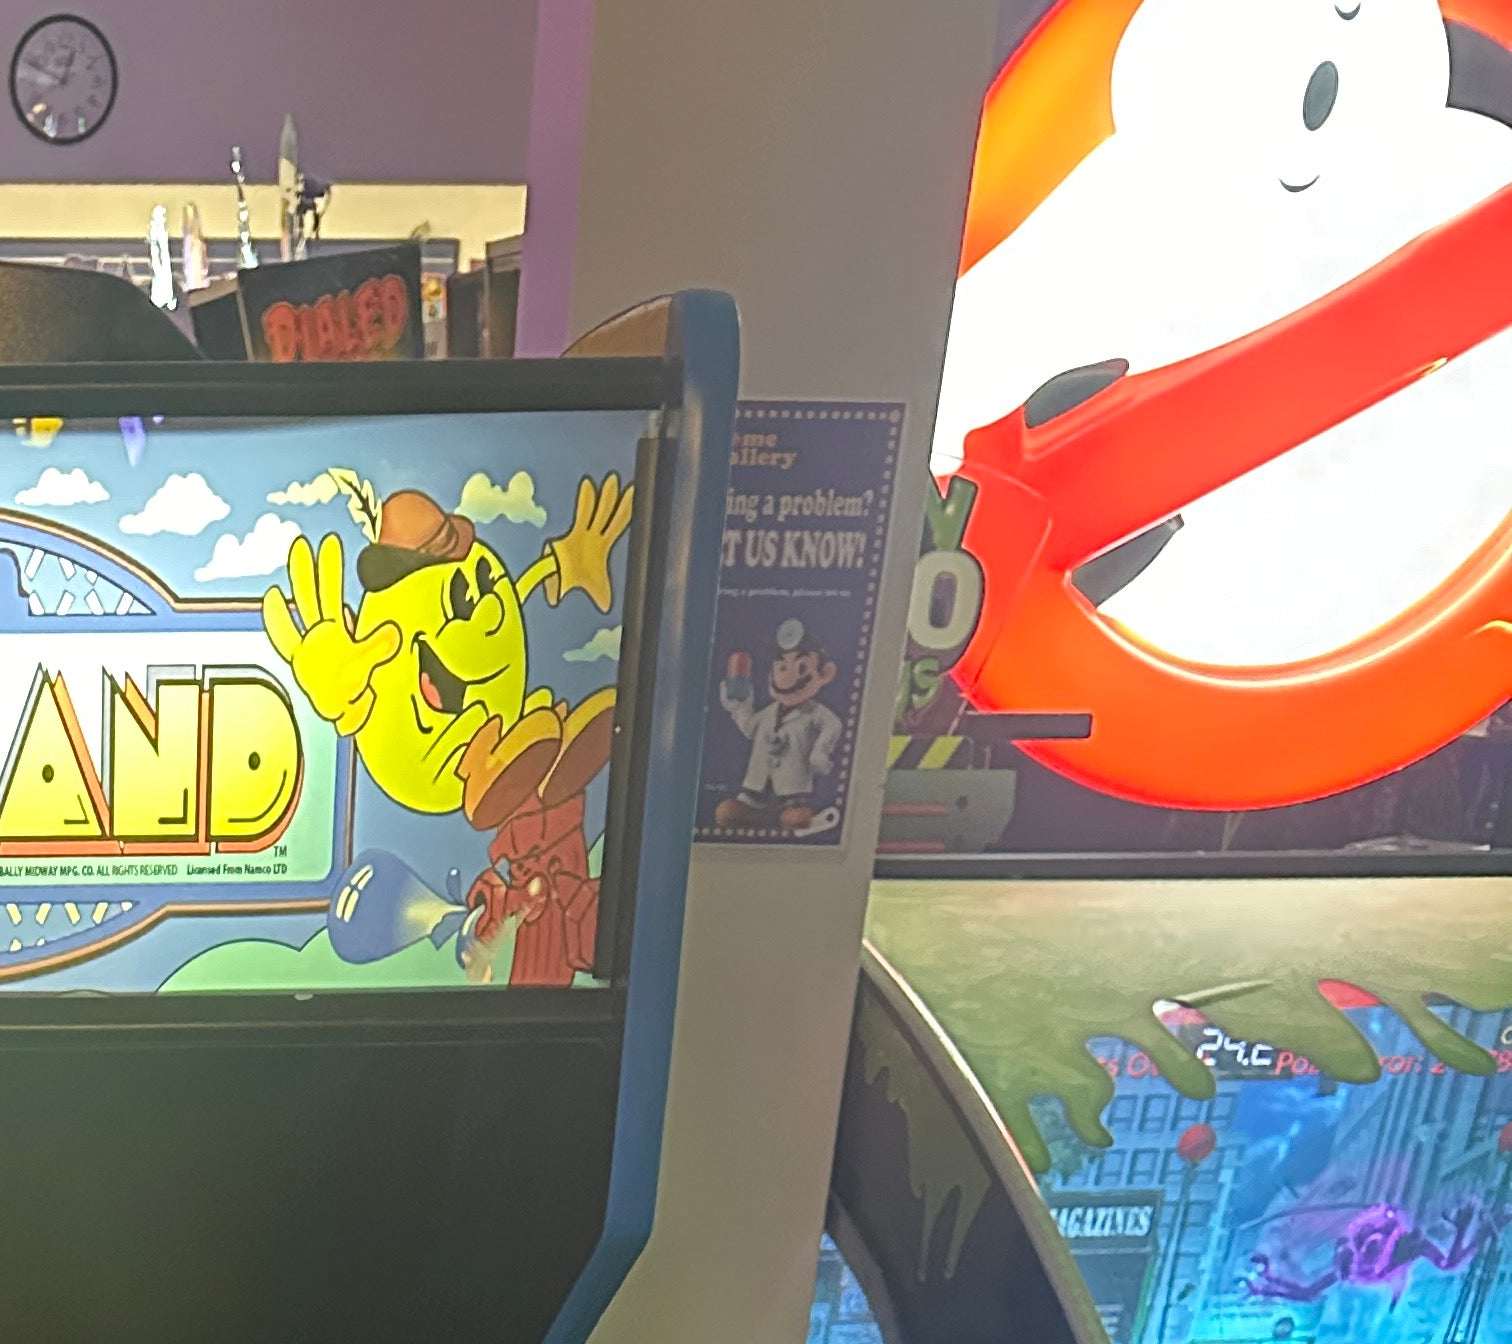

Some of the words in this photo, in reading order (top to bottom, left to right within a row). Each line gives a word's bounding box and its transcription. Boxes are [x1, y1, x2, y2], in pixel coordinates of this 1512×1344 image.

[762, 494, 774, 516] a
[776, 488, 874, 523] problem?
[744, 530, 779, 567] US
[780, 530, 867, 568] KNOW!
[273, 845, 288, 858] TM
[25, 865, 58, 877] MIDWAY
[96, 864, 110, 876] ALL
[112, 864, 139, 876] RIGHTS
[140, 864, 178, 876] RESERVED
[186, 863, 221, 875] Licensed
[222, 863, 243, 875] From
[244, 863, 272, 875] Namco
[273, 863, 288, 875] LTD
